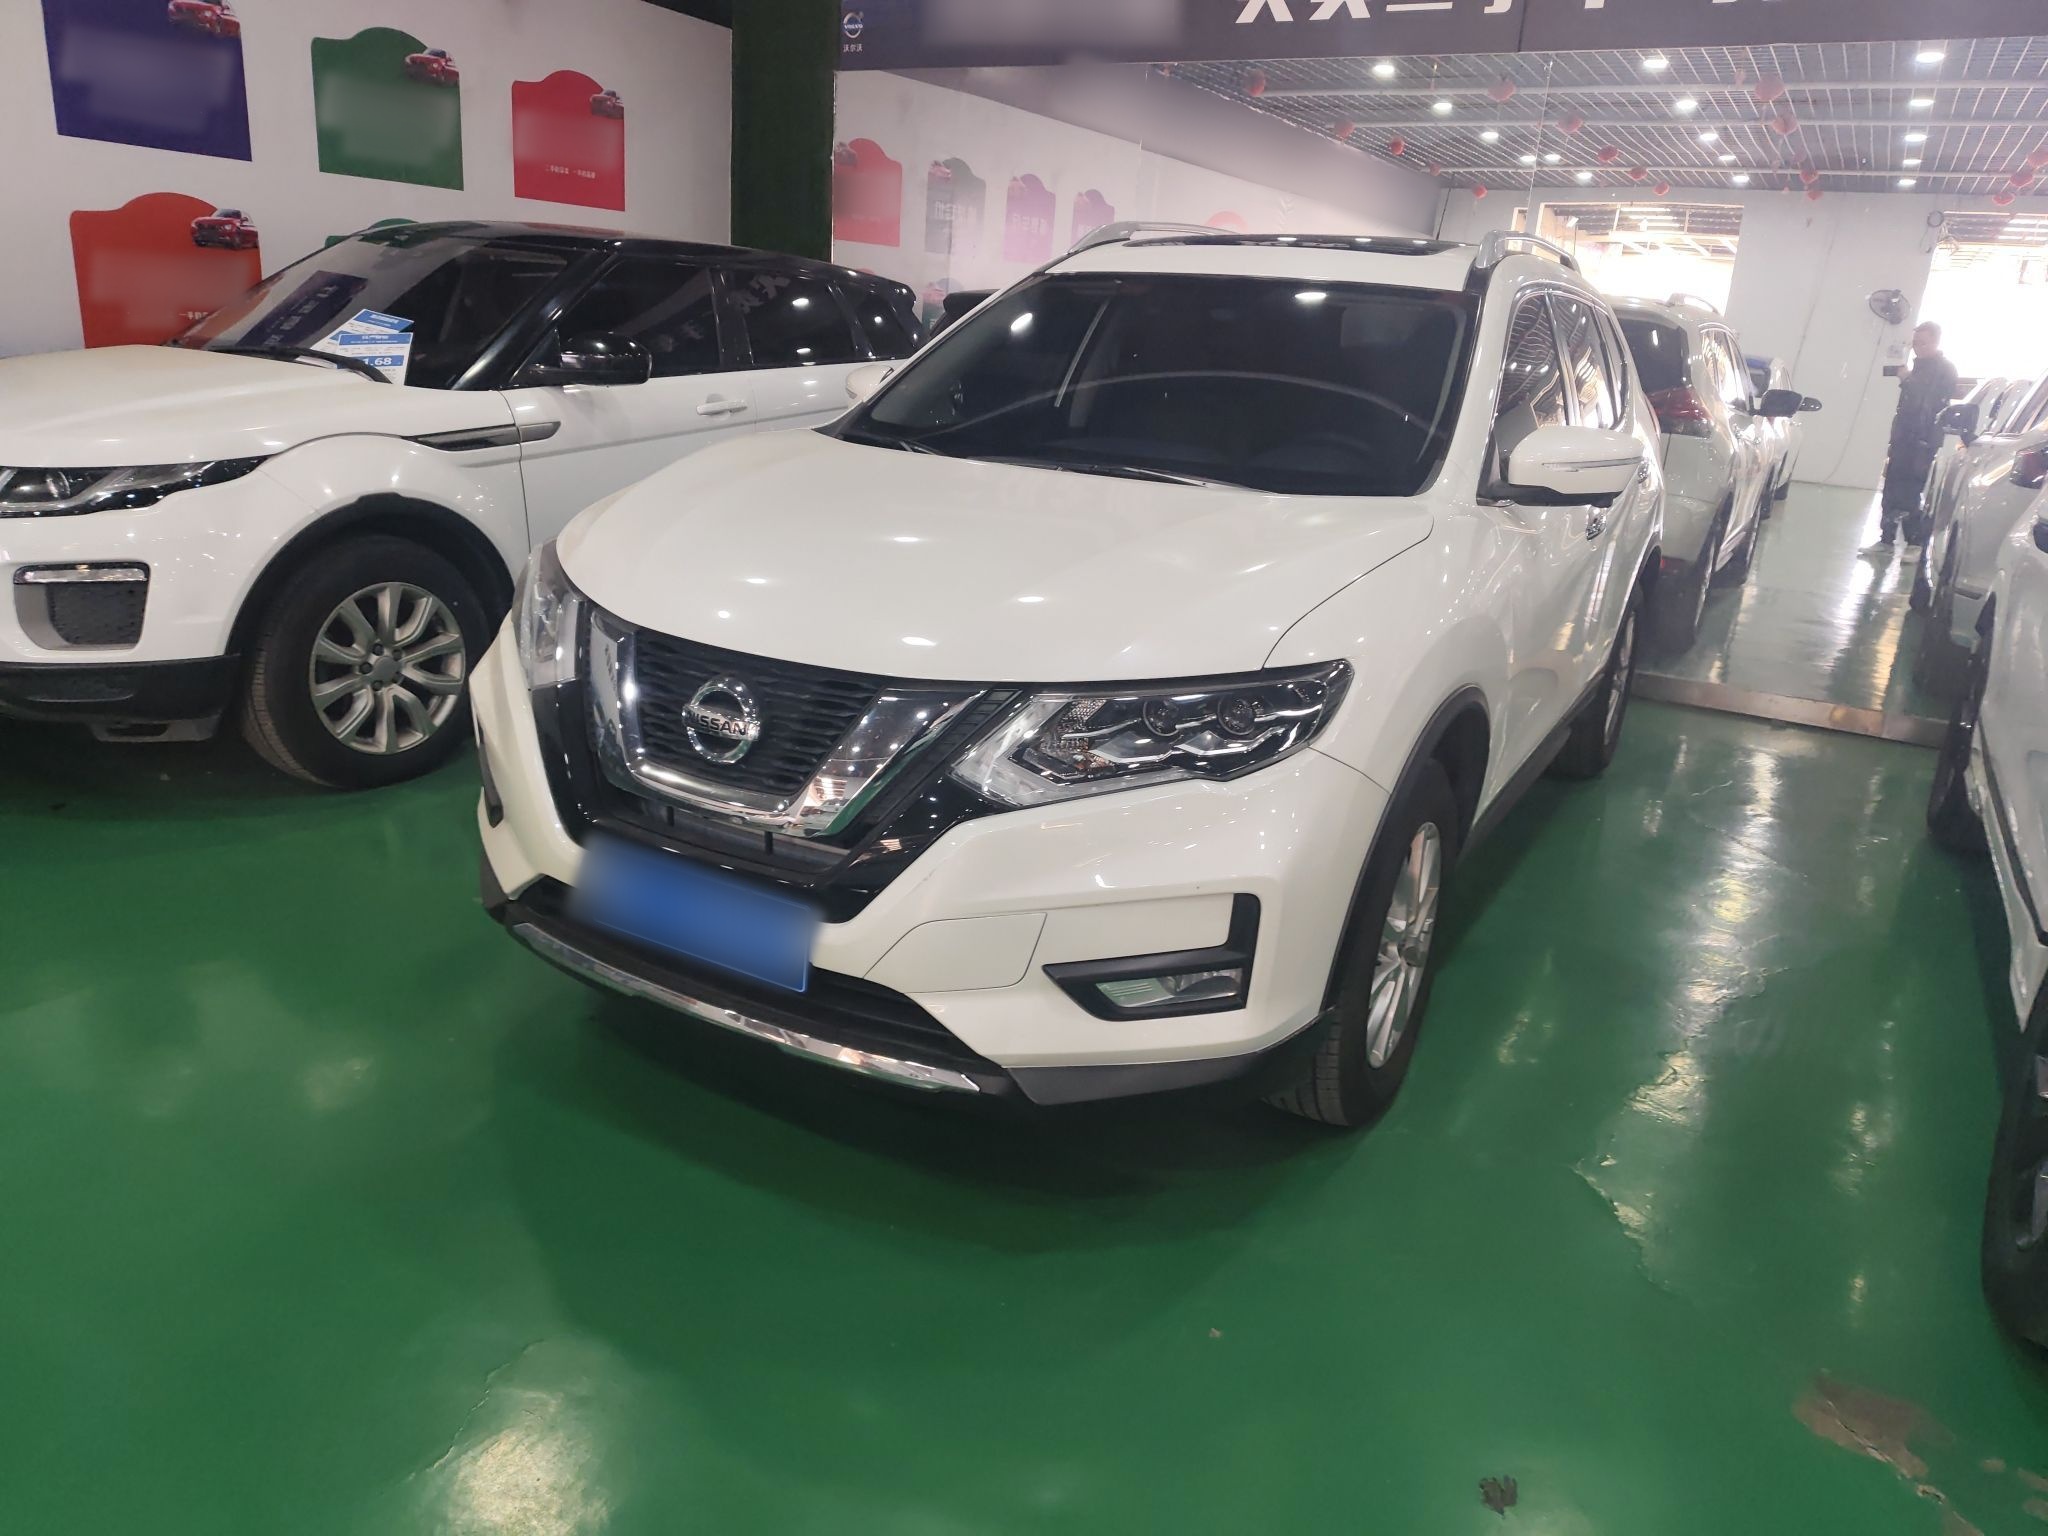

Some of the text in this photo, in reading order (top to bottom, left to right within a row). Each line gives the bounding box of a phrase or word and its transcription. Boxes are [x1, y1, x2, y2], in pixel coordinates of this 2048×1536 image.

[843, 43, 863, 52] 沃尔沃
[684, 709, 748, 736] NISSAN
